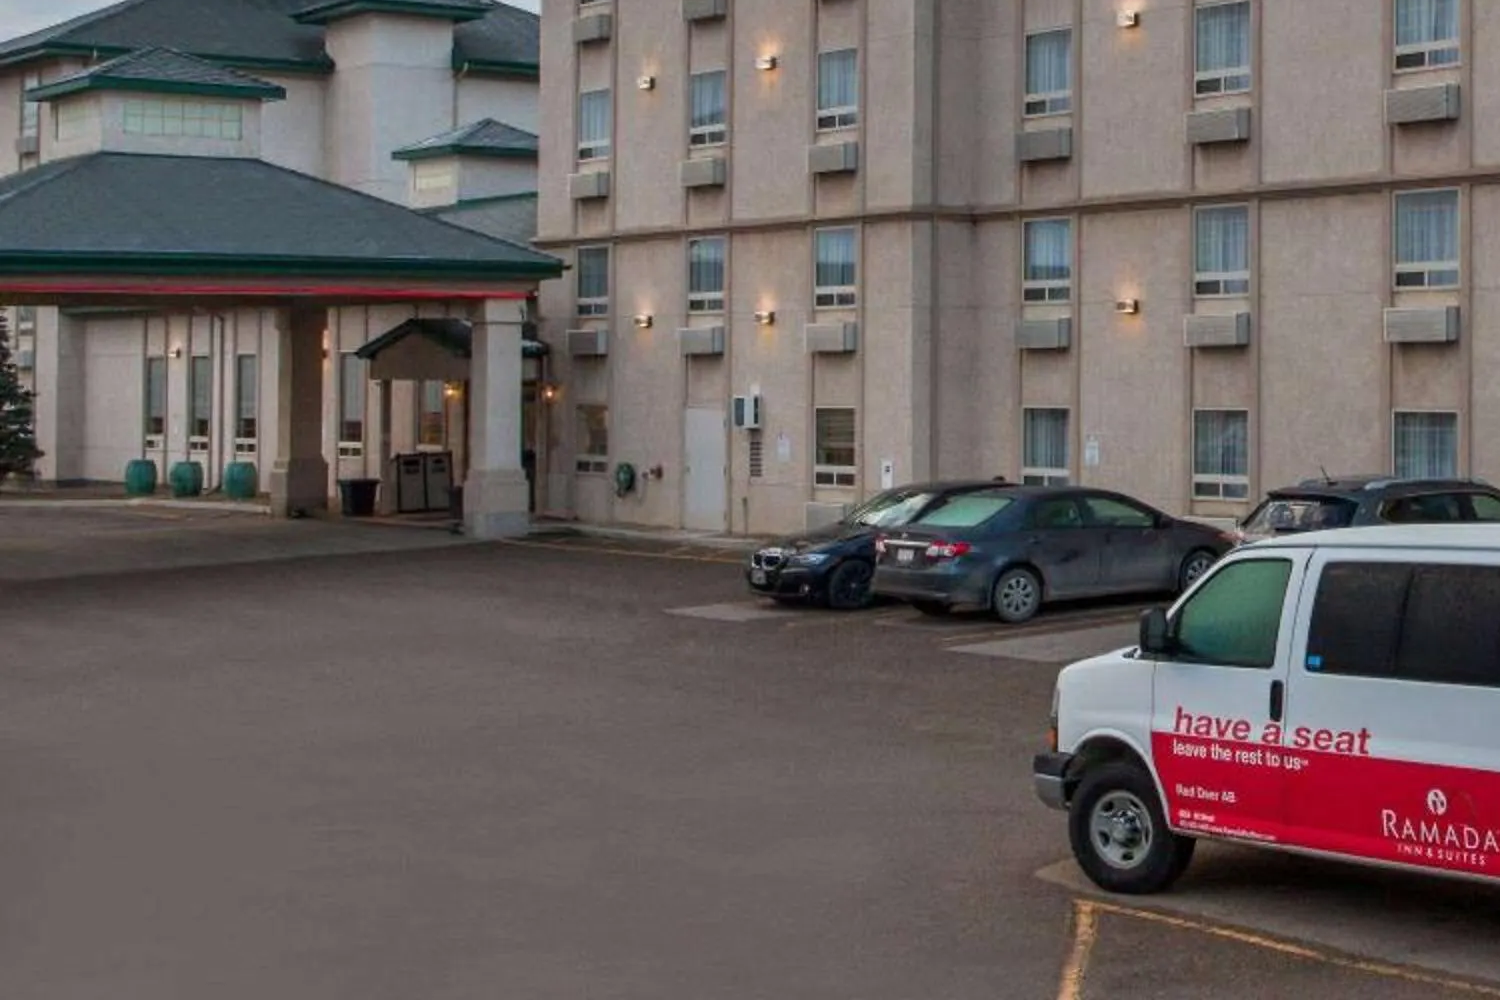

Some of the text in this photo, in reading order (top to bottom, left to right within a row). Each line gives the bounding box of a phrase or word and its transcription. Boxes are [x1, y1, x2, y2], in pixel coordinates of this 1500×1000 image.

[1173, 705, 1371, 755] have a seat
[1172, 739, 1207, 760] leave
[1210, 743, 1233, 762] the
[1234, 747, 1263, 766] rest
[1265, 752, 1281, 768] to
[1381, 808, 1500, 853] RAMADA
[1397, 842, 1423, 857] INN
[1437, 848, 1487, 867] SUITES
